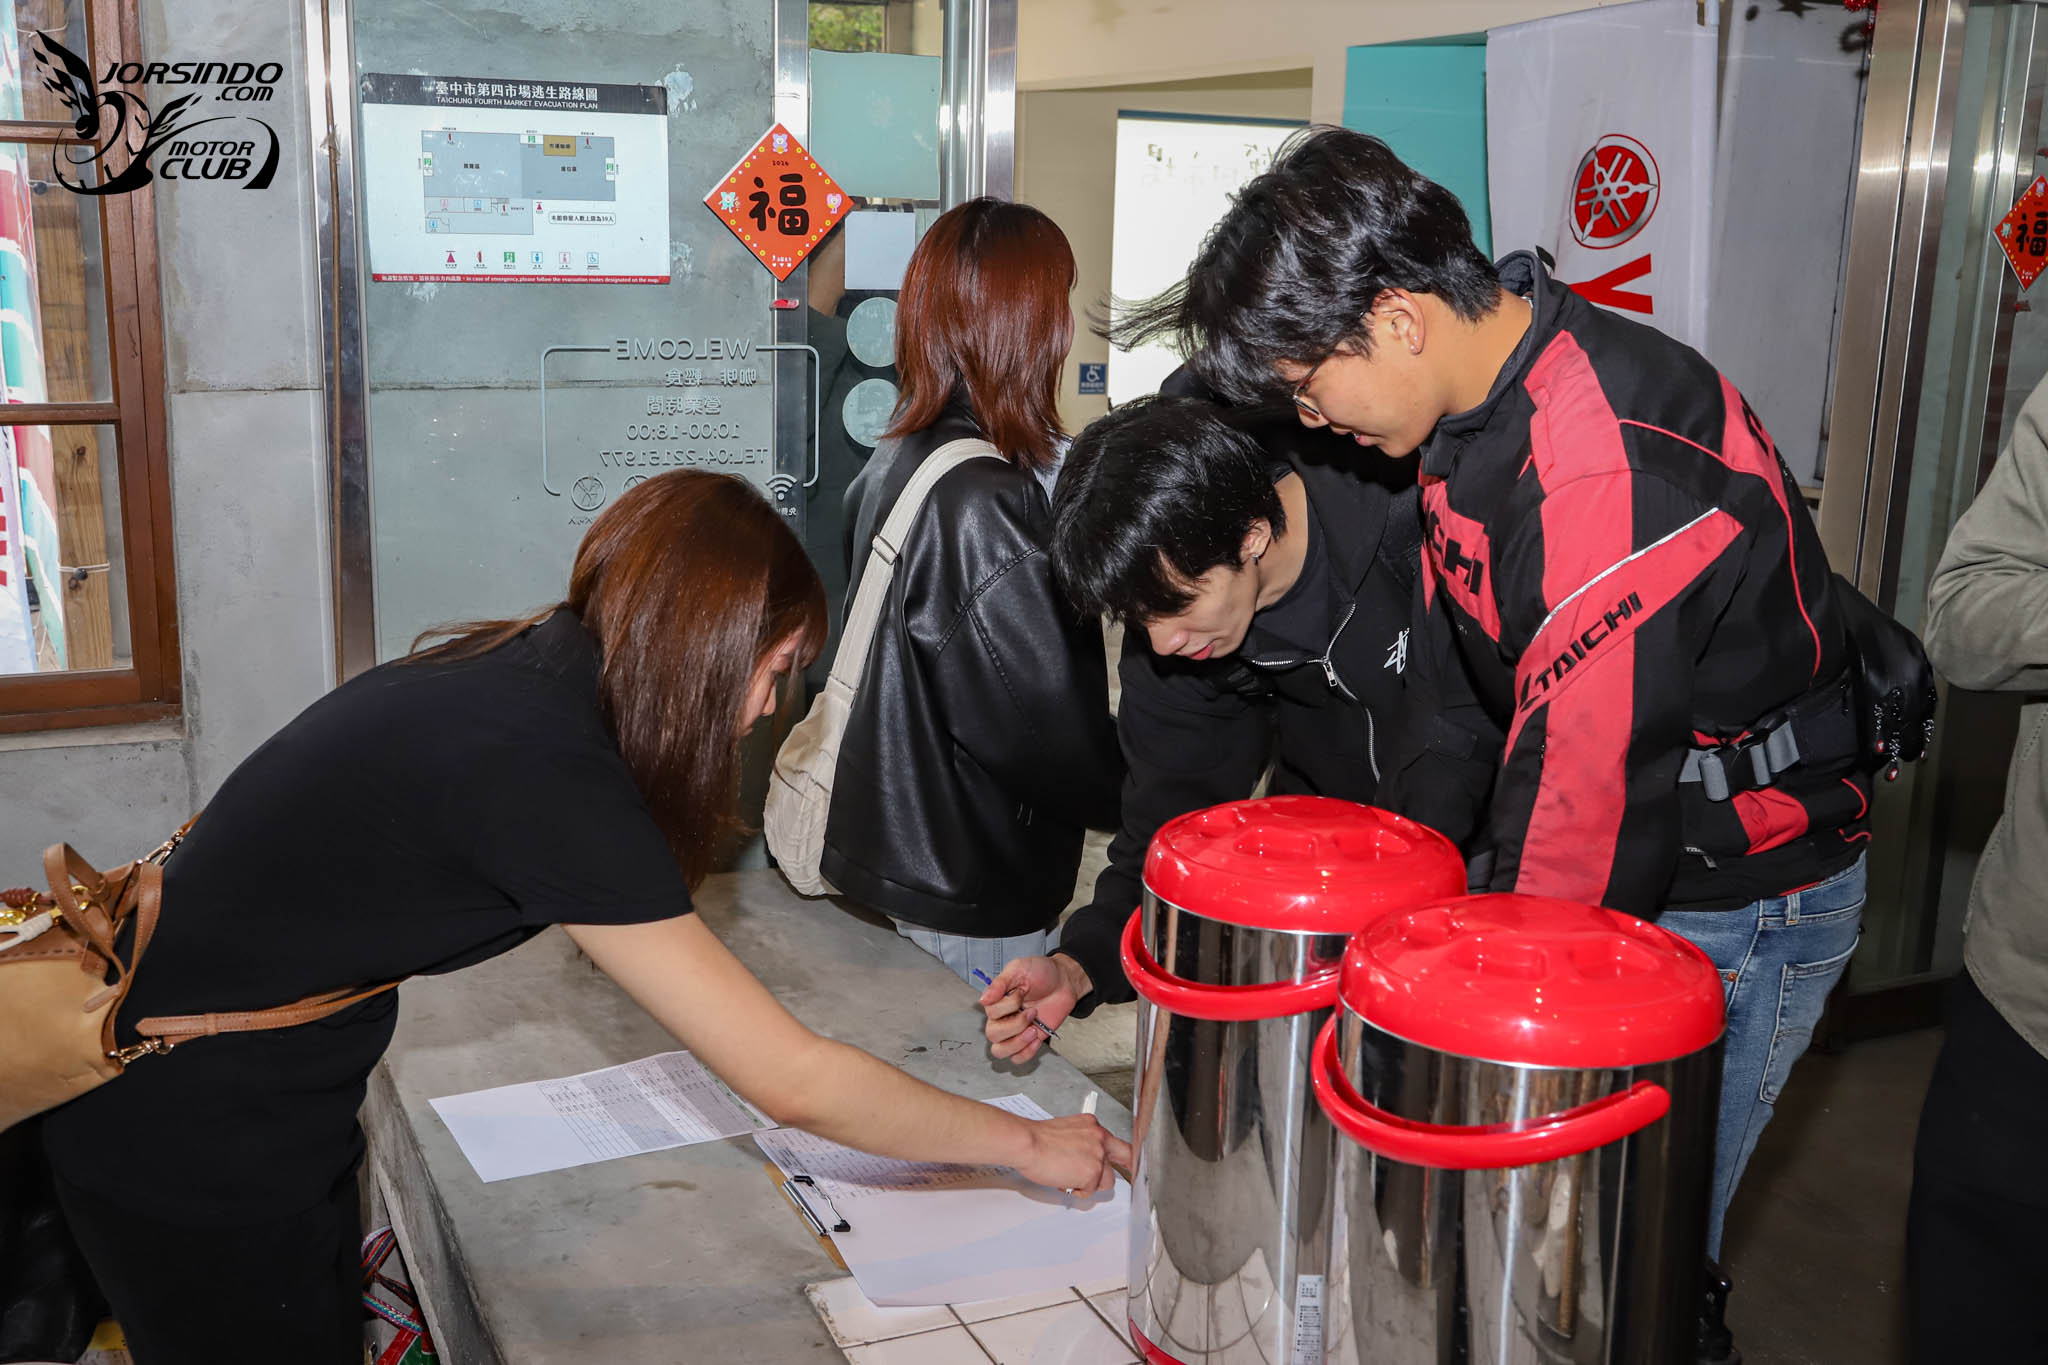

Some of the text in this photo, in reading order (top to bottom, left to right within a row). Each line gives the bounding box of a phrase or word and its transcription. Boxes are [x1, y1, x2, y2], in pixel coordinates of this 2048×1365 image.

[436, 81, 598, 101] 臺中市第四市場逃生路線圖
[437, 96, 473, 105] TAICHUNG
[504, 99, 532, 107] MARKET
[534, 100, 578, 109] EVACUATION
[748, 173, 810, 236] 福
[2016, 211, 2048, 256] 福
[1535, 591, 1643, 692] TAICHI
